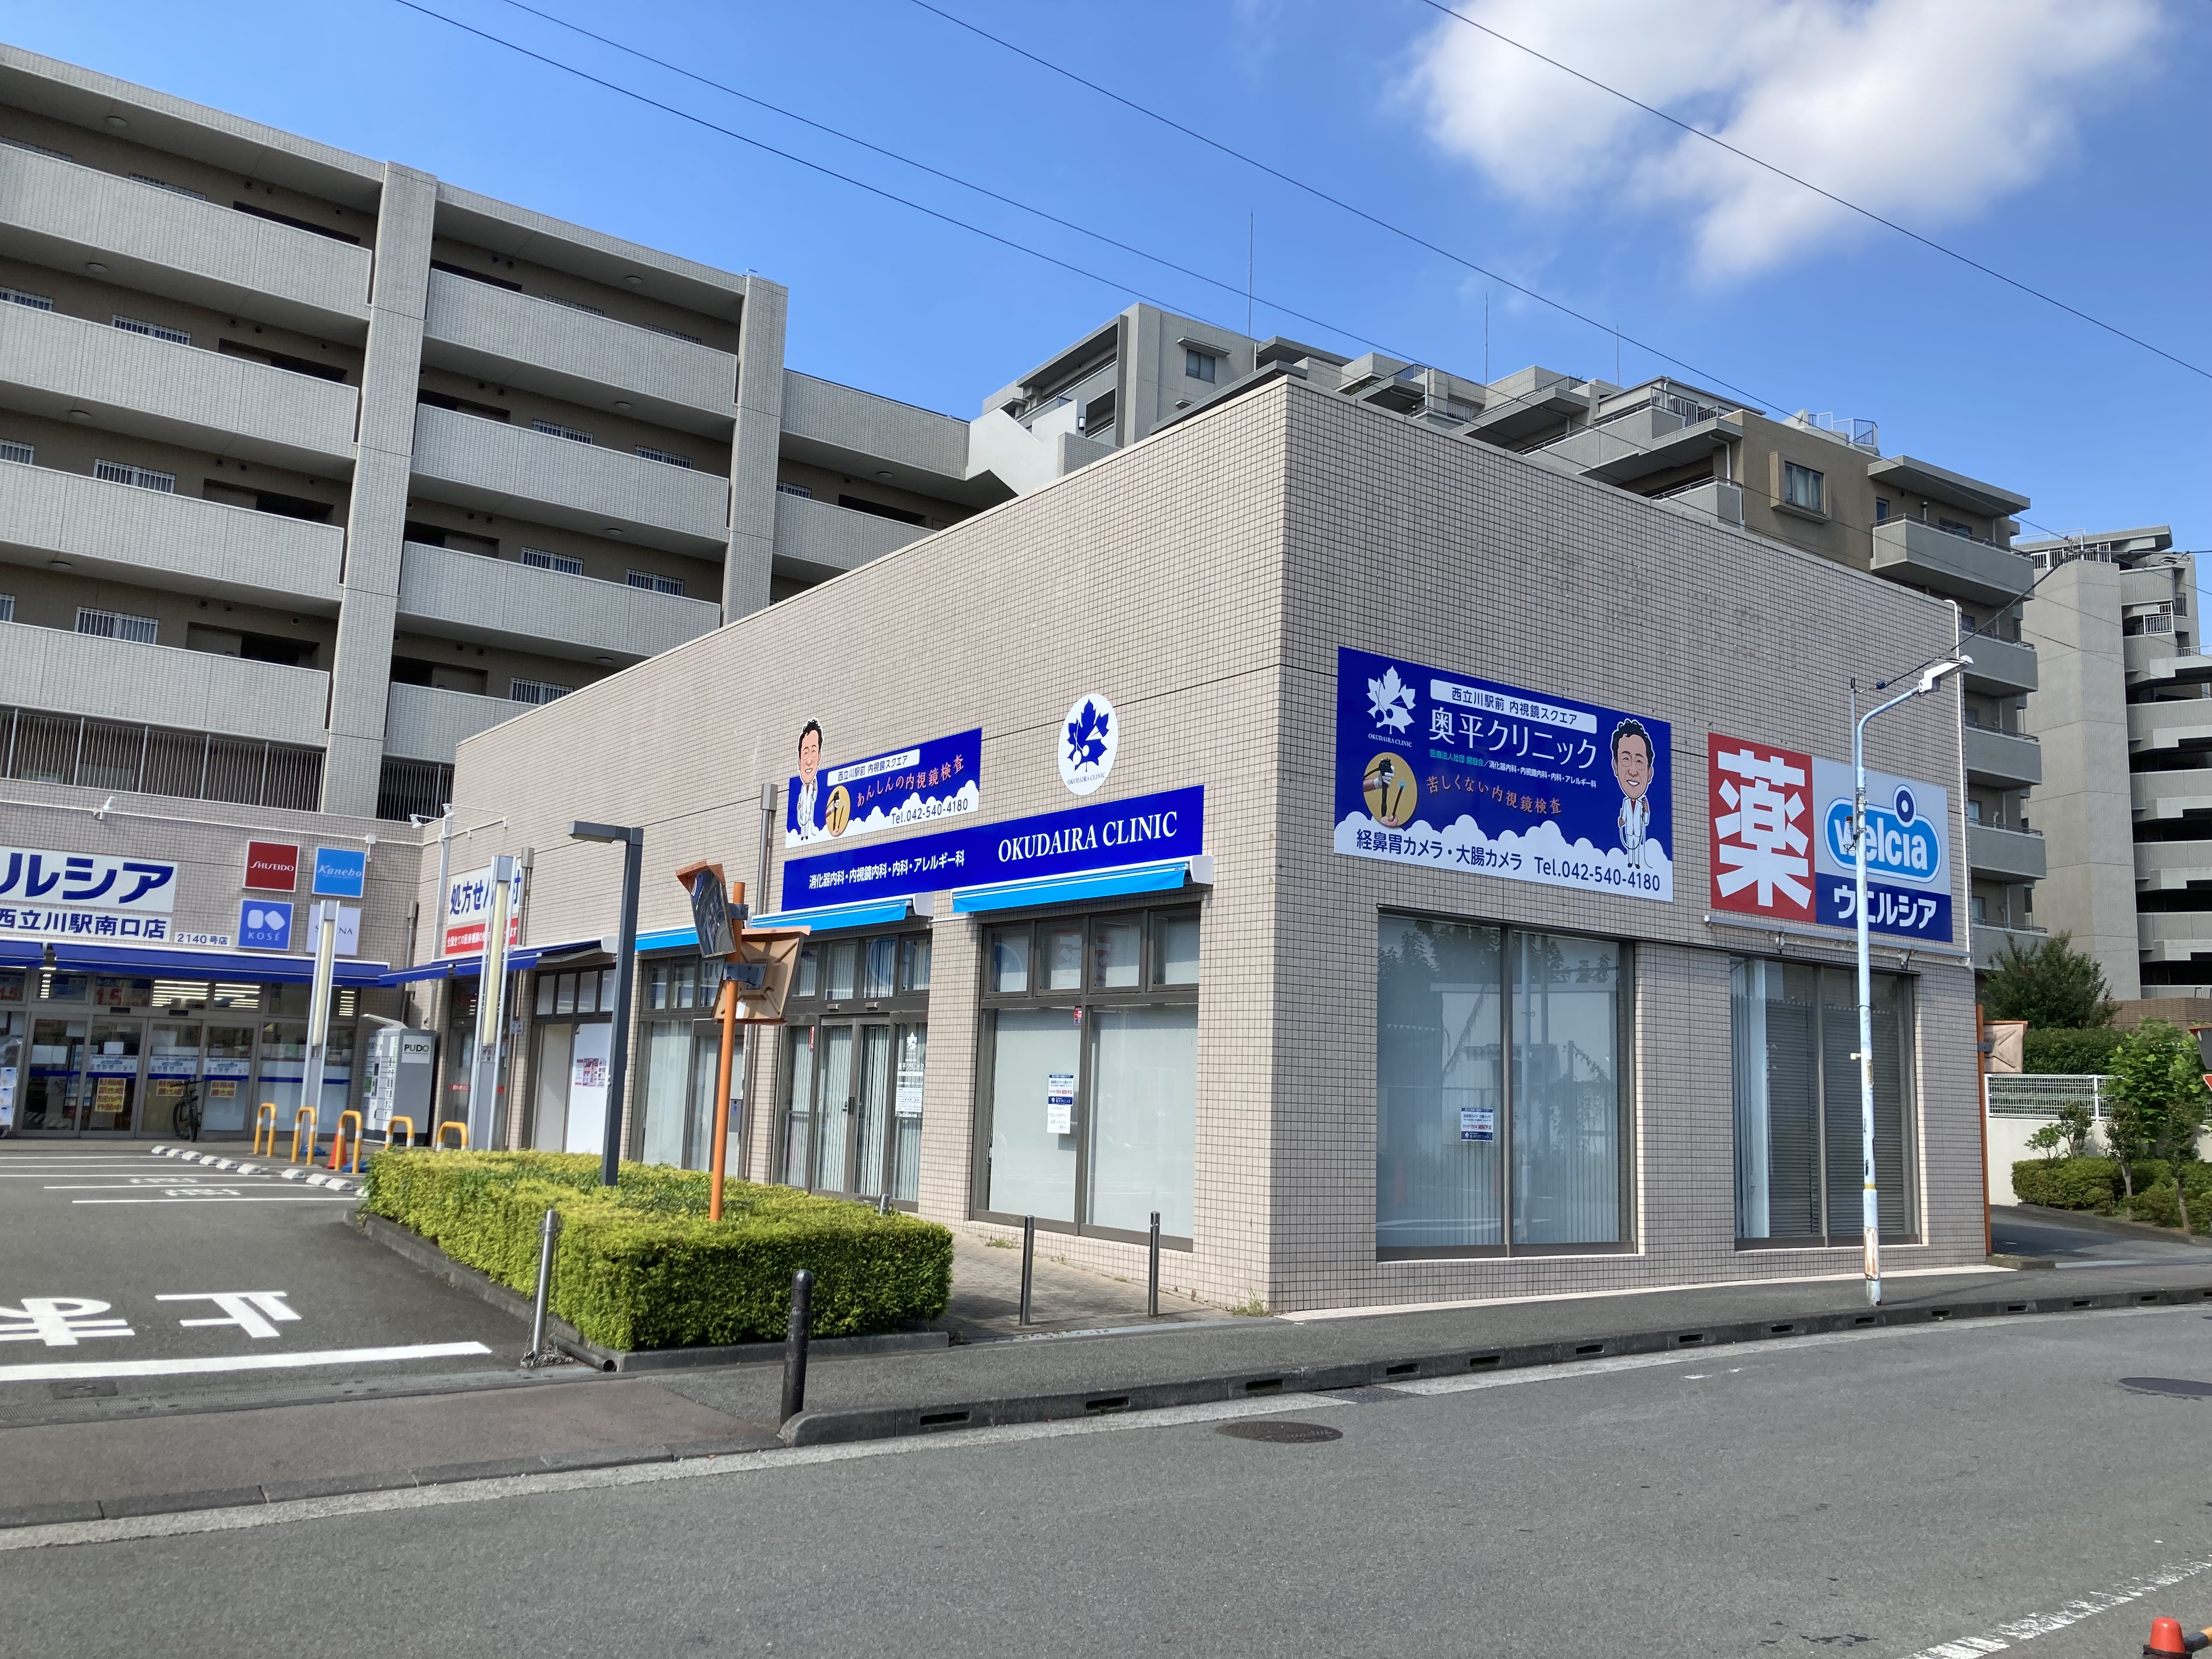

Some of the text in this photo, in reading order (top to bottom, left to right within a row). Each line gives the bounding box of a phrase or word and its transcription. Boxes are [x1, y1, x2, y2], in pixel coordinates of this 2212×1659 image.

[1452, 687, 1577, 725] 西立川駅前 内視鏡スクエア
[1368, 733, 1413, 748] OKUDAIRA CLINIC
[1429, 706, 1596, 769] 奥平クリニック
[838, 754, 908, 782] 西立川駅前 内視鏡スクエア
[857, 754, 964, 808] あんしんの内視鏡検査
[1067, 772, 1105, 786] OKUDAIRA CLINIC
[1426, 774, 1561, 814] 苦しくない内視鏡検査
[891, 798, 968, 825] Tel.042-540-4180
[998, 811, 1177, 862] OKUDAIRA CLINIC
[1714, 748, 1812, 910] 薬
[250, 861, 294, 872] SHISEIDO
[318, 865, 362, 877] Kanebo
[809, 850, 964, 889] 消化器内科・内視鏡内科・内科・アレルギー科
[1356, 828, 1660, 891] 経鼻胃カメラ・大腸カメラ Tel.042-540-4180
[0, 908, 167, 939] 西立川駅南口店
[248, 931, 281, 941] KOSÉ
[404, 1044, 430, 1052] PUDO
